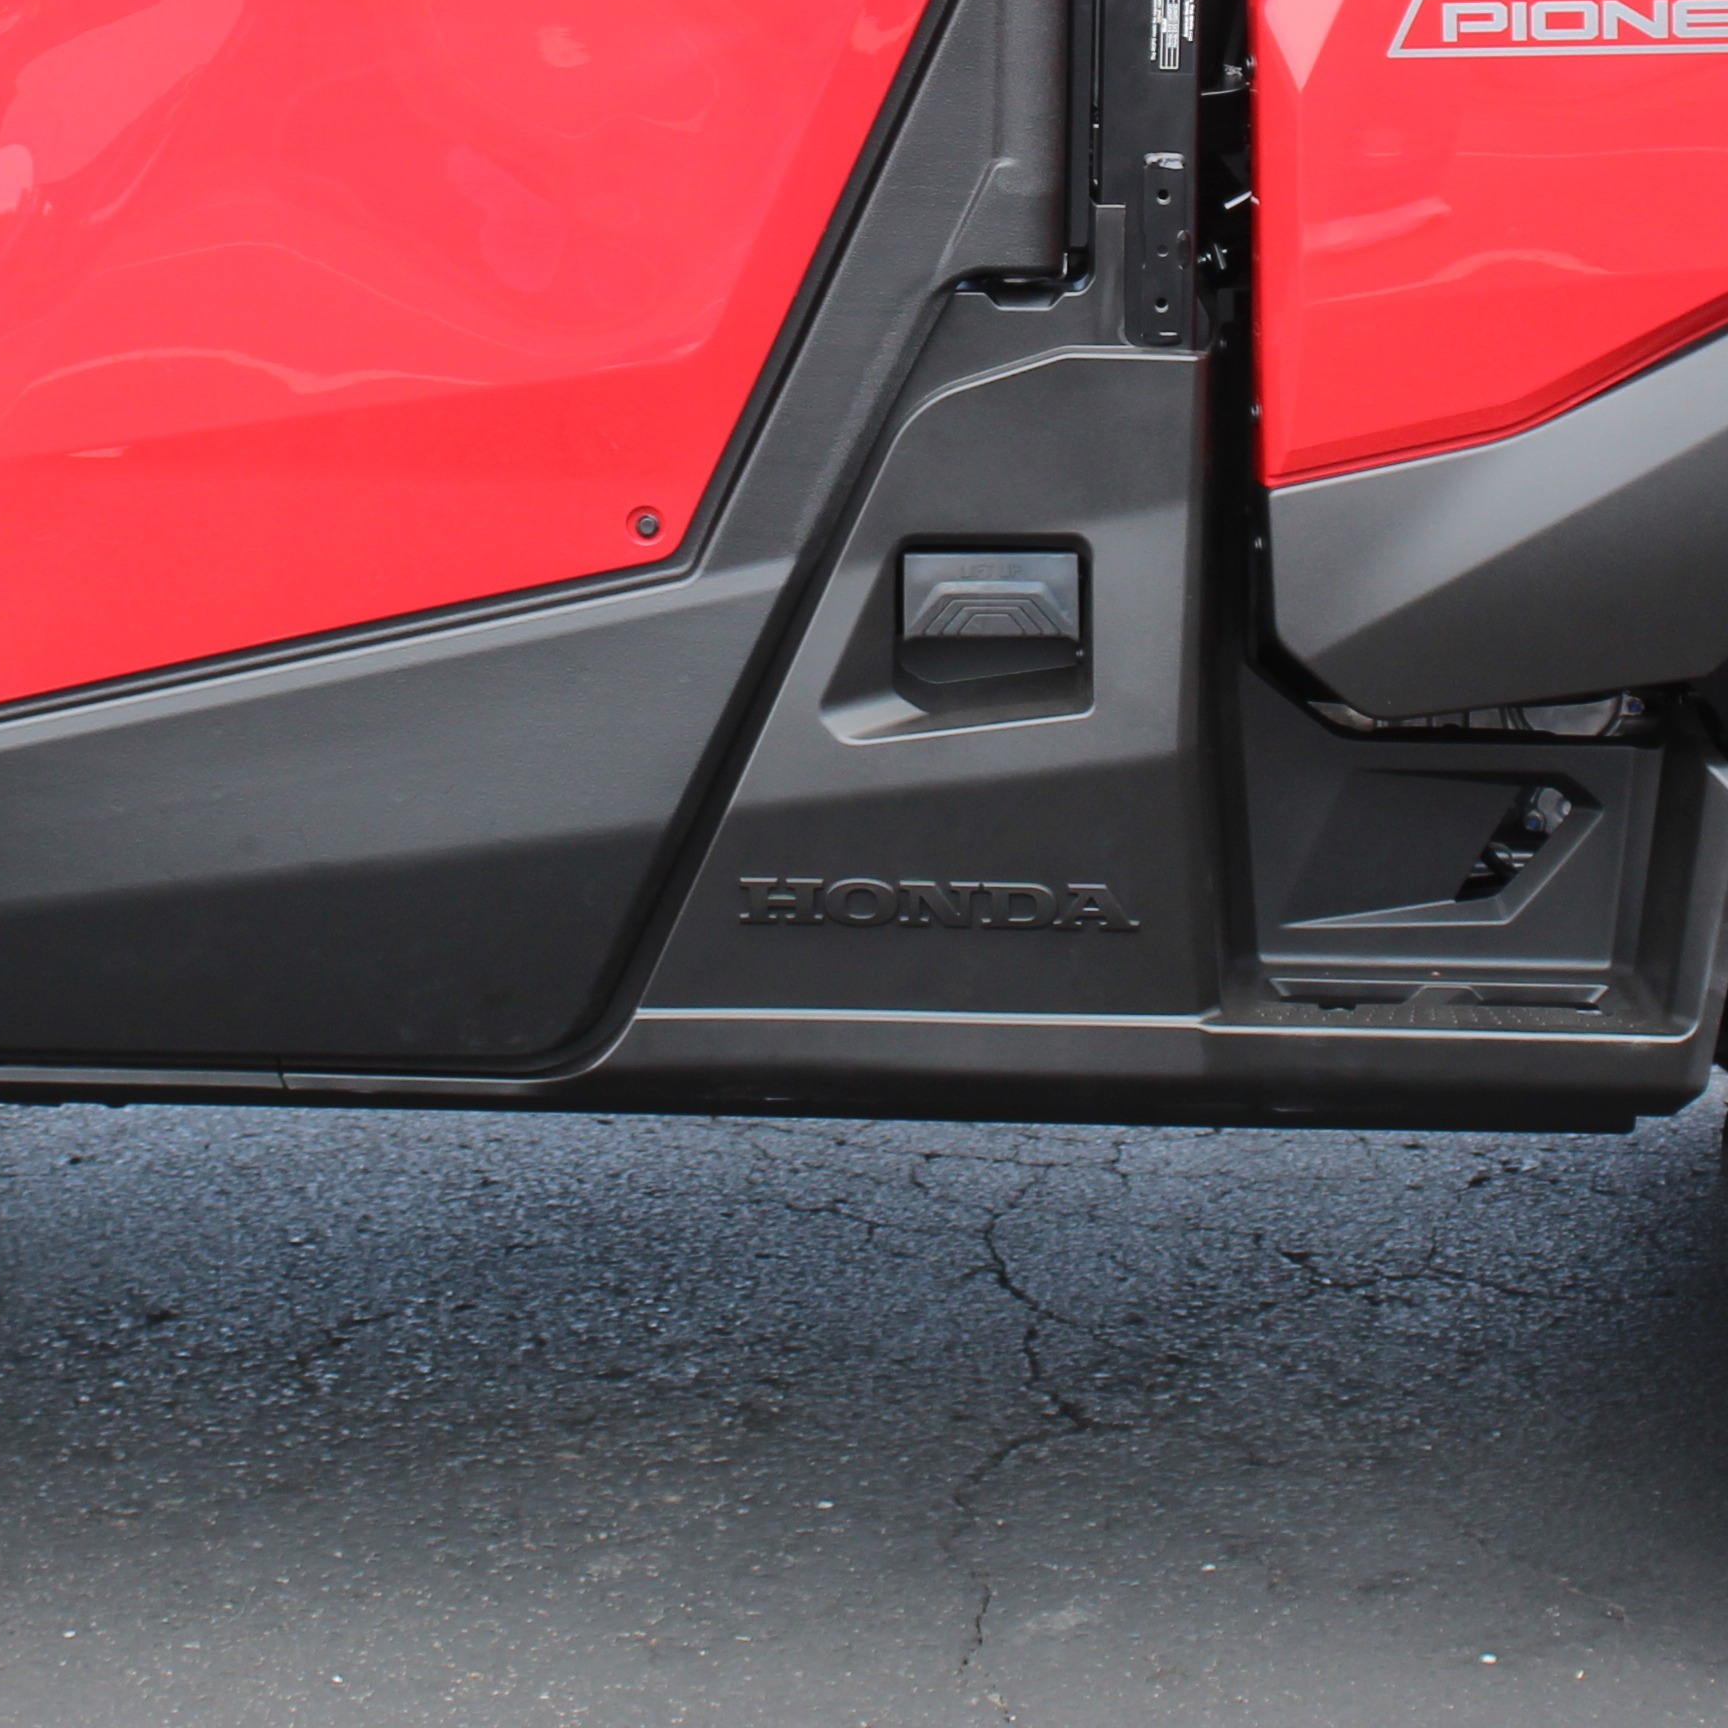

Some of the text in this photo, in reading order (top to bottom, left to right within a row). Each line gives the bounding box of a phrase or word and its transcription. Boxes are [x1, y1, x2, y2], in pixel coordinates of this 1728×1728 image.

[960, 564, 1023, 578] LIFT UP
[739, 877, 1140, 930] HONDA
